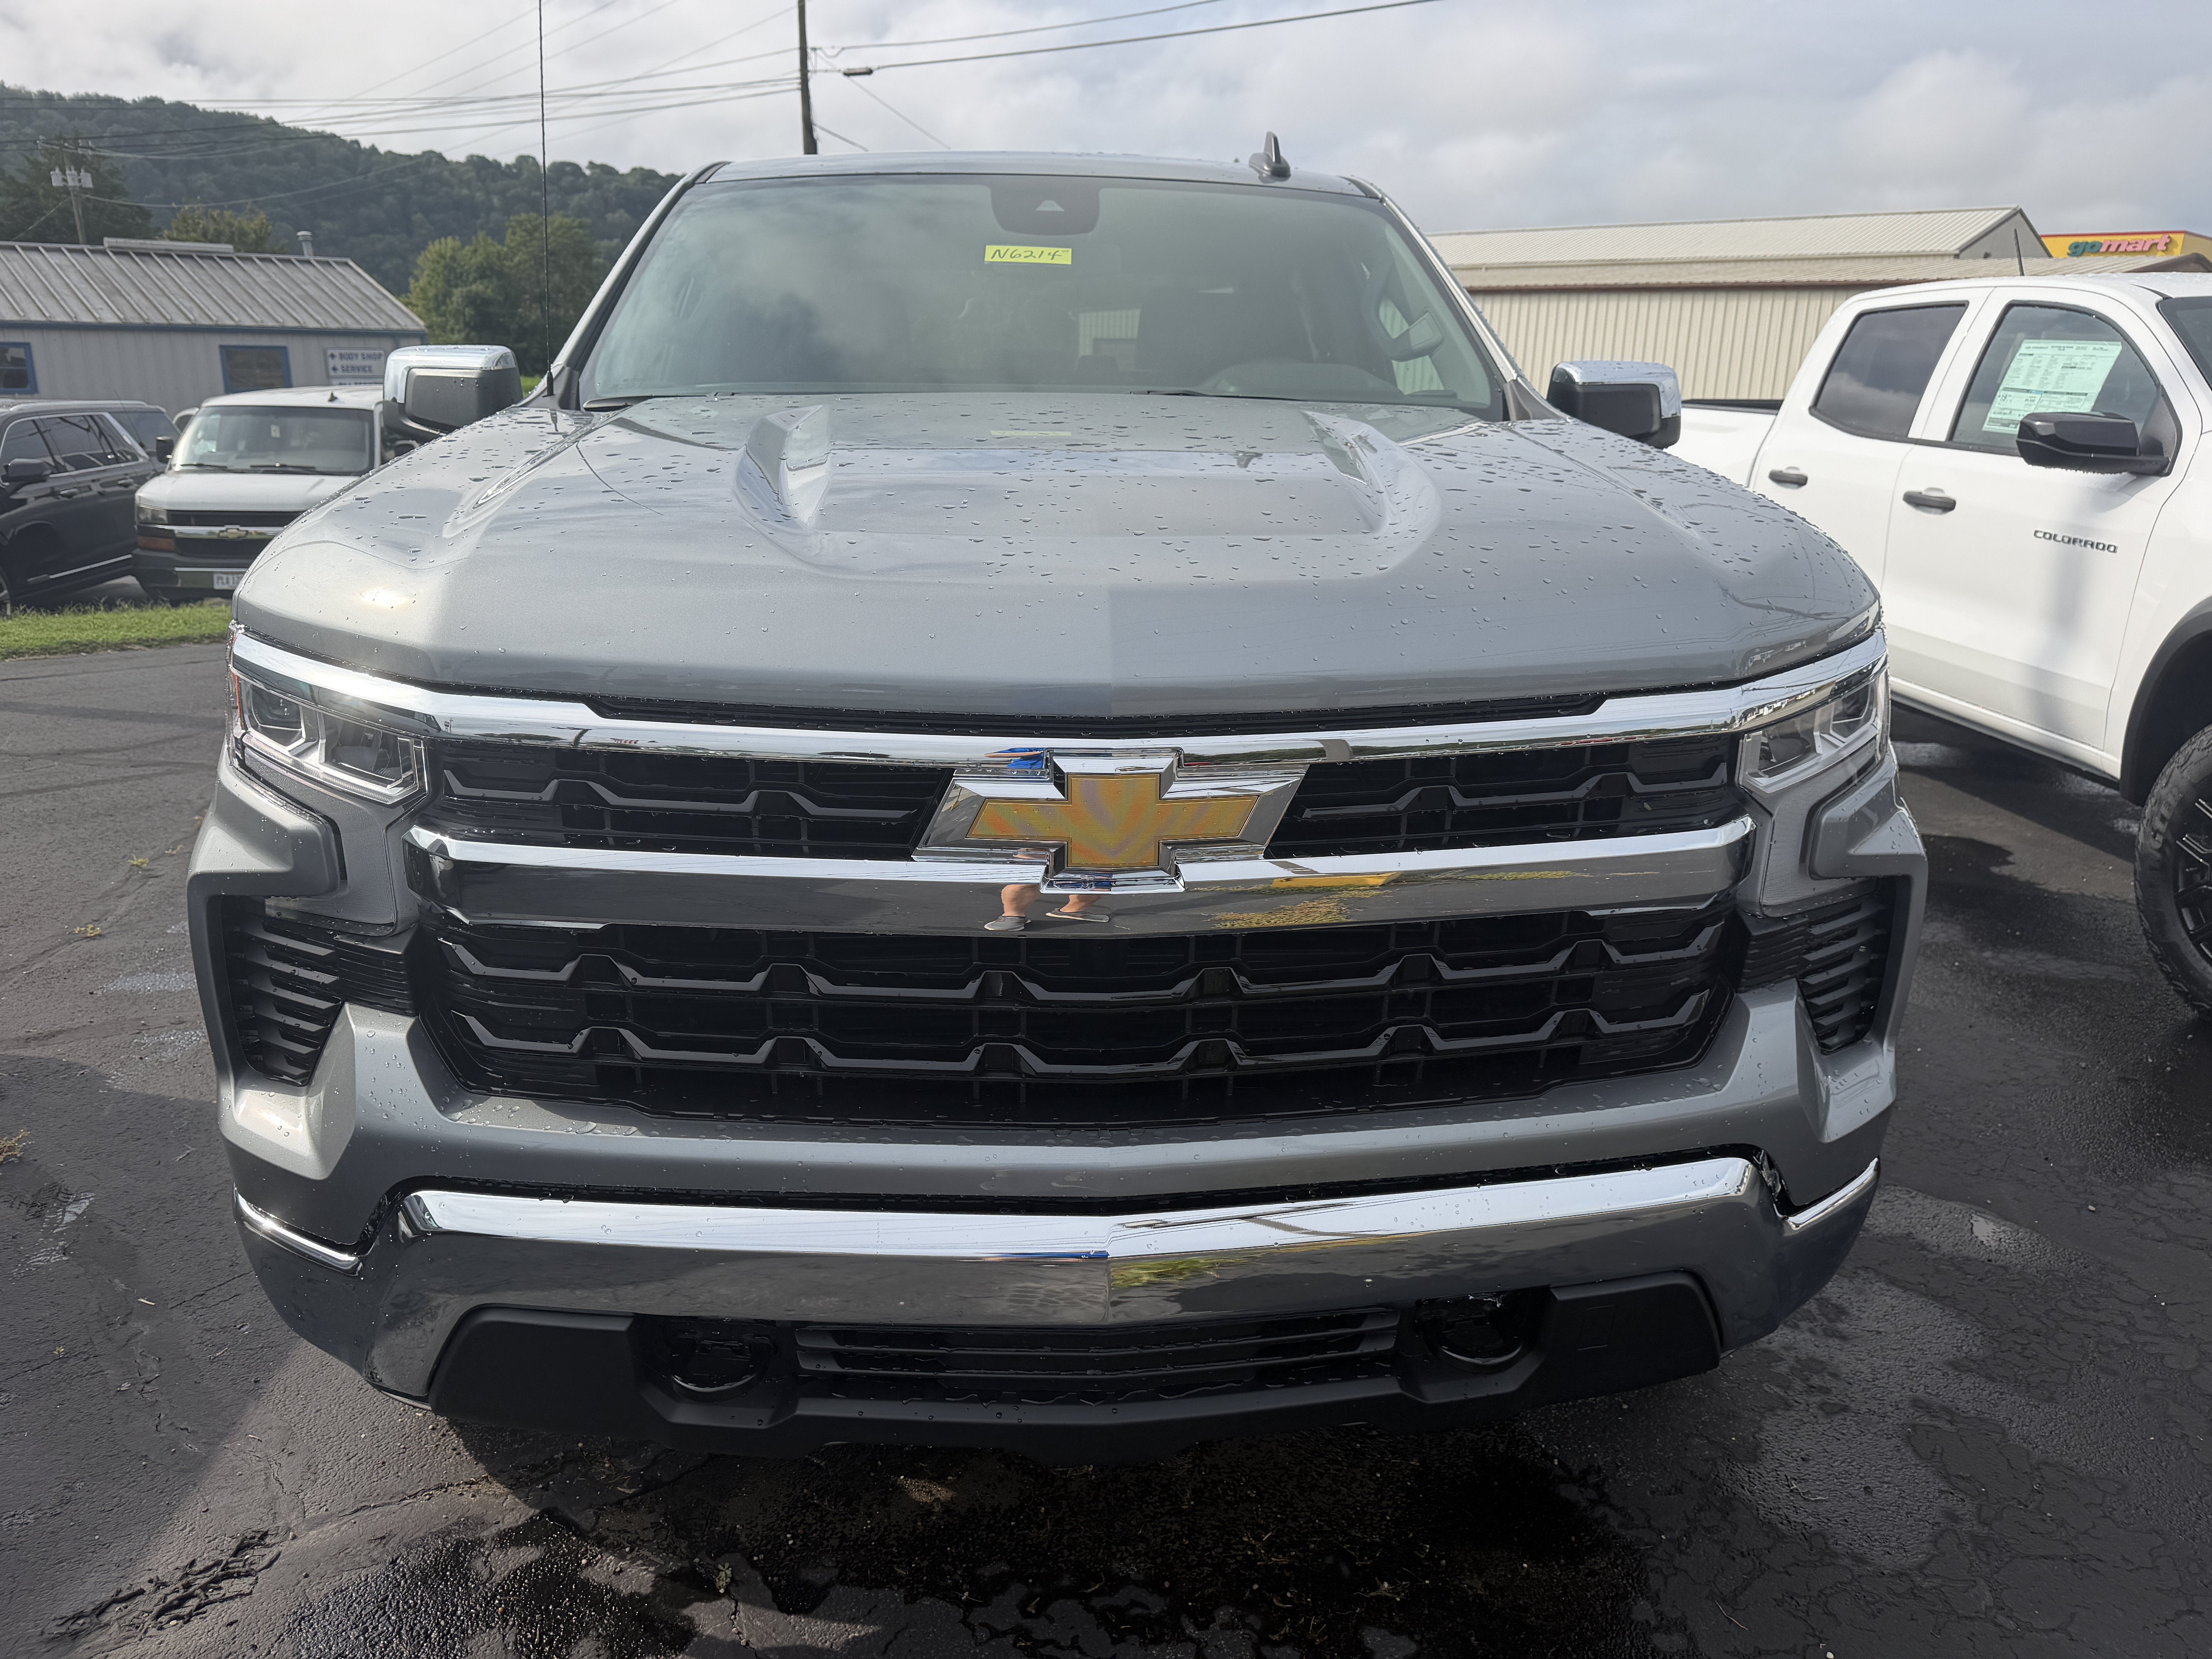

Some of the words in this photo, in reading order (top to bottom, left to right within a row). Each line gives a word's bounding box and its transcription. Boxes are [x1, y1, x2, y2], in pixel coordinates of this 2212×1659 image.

[2067, 235, 2171, 256] gomart
[991, 248, 1062, 260] N6214
[339, 352, 359, 361] BODY
[361, 352, 382, 361] SHOP
[341, 364, 372, 373] SERVICE
[2033, 530, 2118, 553] COLORADO
